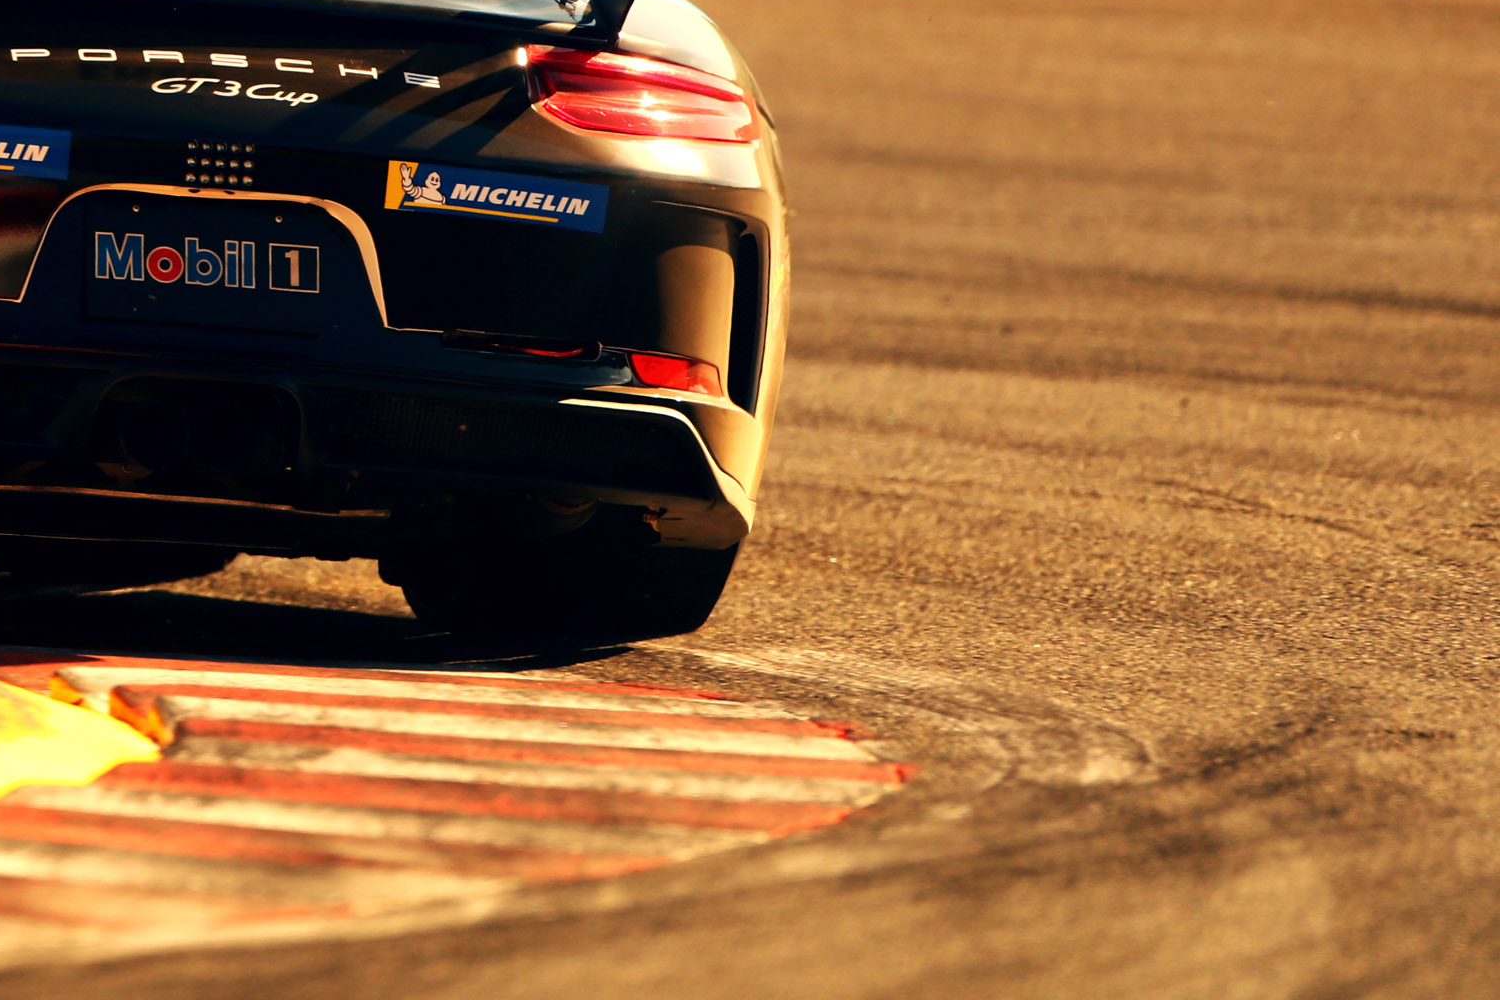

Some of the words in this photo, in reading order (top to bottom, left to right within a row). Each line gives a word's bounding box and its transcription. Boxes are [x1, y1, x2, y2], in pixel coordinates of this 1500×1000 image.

[10, 48, 441, 89] PORSCHE
[246, 84, 319, 107] Cup
[450, 183, 590, 216] MICHELIN
[95, 231, 256, 289] Mobil
[284, 250, 300, 287] 1
